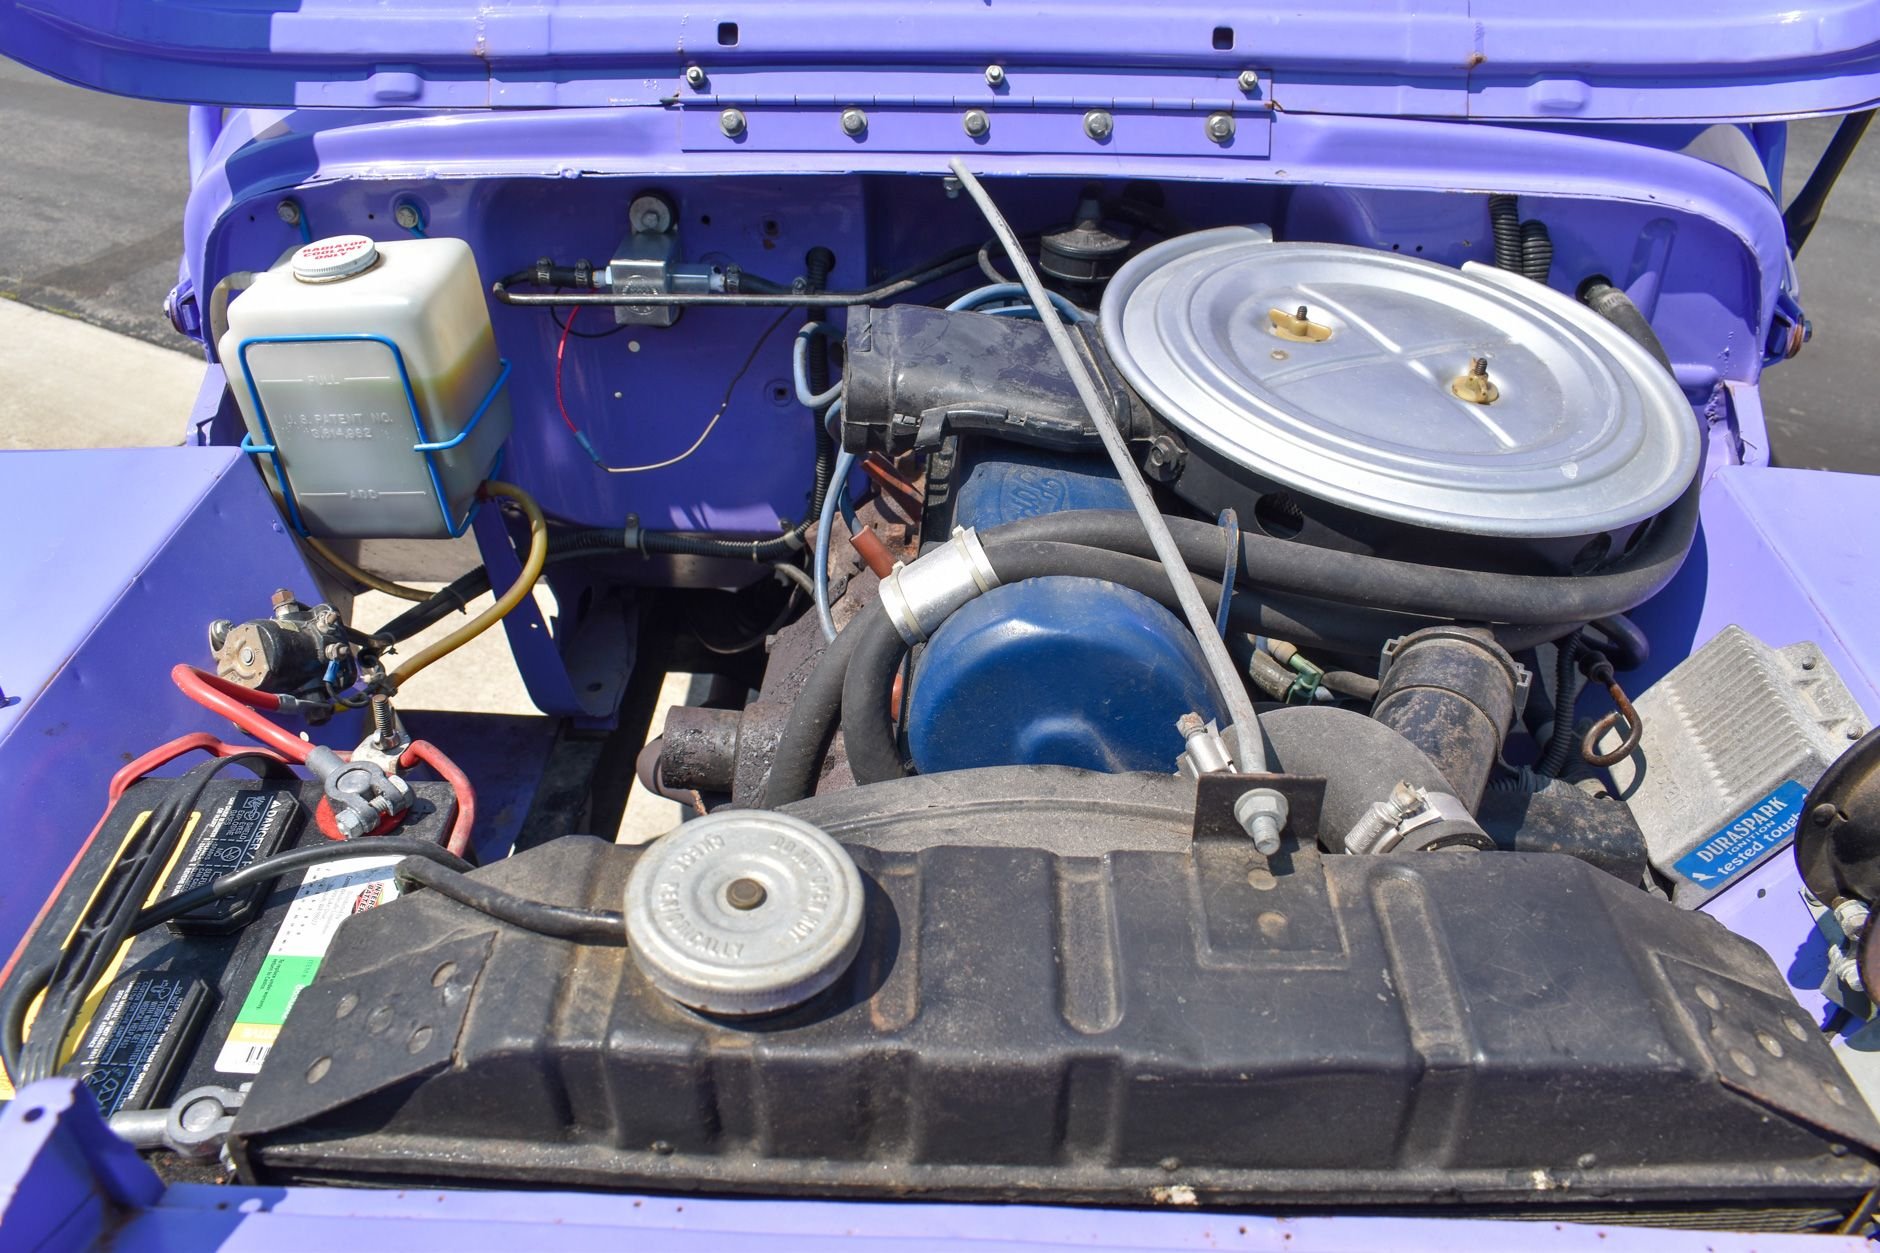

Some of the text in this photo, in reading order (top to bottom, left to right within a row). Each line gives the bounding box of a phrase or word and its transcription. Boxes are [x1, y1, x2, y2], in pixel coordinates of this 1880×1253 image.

[302, 240, 367, 253] RADIATOR
[303, 245, 362, 258] COOLANT
[314, 252, 347, 260] ONLY
[307, 375, 340, 385] FULL
[313, 413, 362, 424] PATENT
[349, 489, 379, 500] ADD
[247, 809, 277, 850] DANGER
[1695, 796, 1789, 863] DURASPARK
[1727, 820, 1776, 856] IGNITION
[1717, 841, 1765, 875] tested
